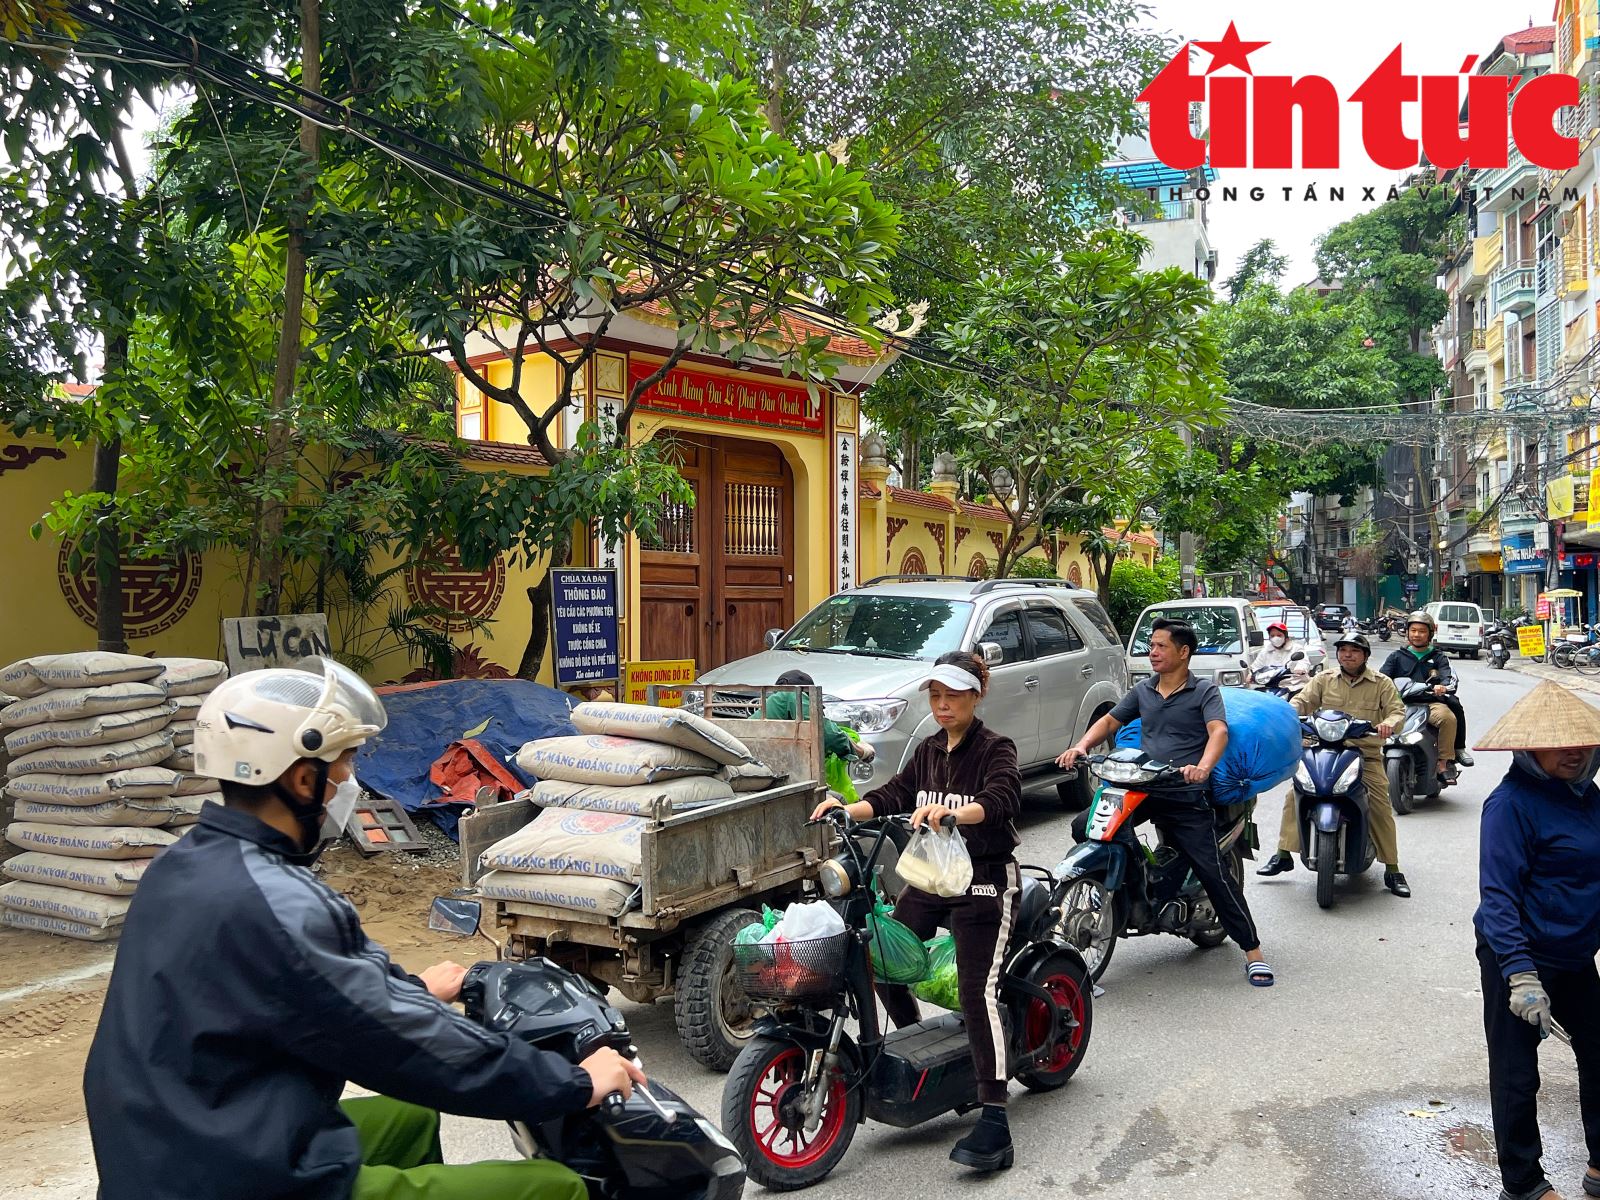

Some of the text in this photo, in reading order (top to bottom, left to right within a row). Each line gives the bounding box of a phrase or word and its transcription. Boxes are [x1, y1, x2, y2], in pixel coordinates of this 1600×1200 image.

[563, 586, 606, 601] THÔNG BÁO
[594, 622, 601, 633] XE
[631, 668, 653, 683] KHÔNG
[683, 669, 690, 680] XE
[614, 762, 640, 775] LONG
[14, 782, 38, 793] LONG
[614, 800, 641, 813] LONG
[21, 831, 32, 841] XI
[91, 839, 113, 849] LONG
[9, 863, 35, 874] LONG
[495, 855, 508, 865] XI
[594, 862, 627, 877] LONG
[97, 876, 107, 885] XI
[3, 894, 28, 905] LONG
[484, 885, 496, 896] XI
[567, 895, 597, 909] LONG
[88, 911, 98, 921] XI
[69, 923, 91, 935] LONG
